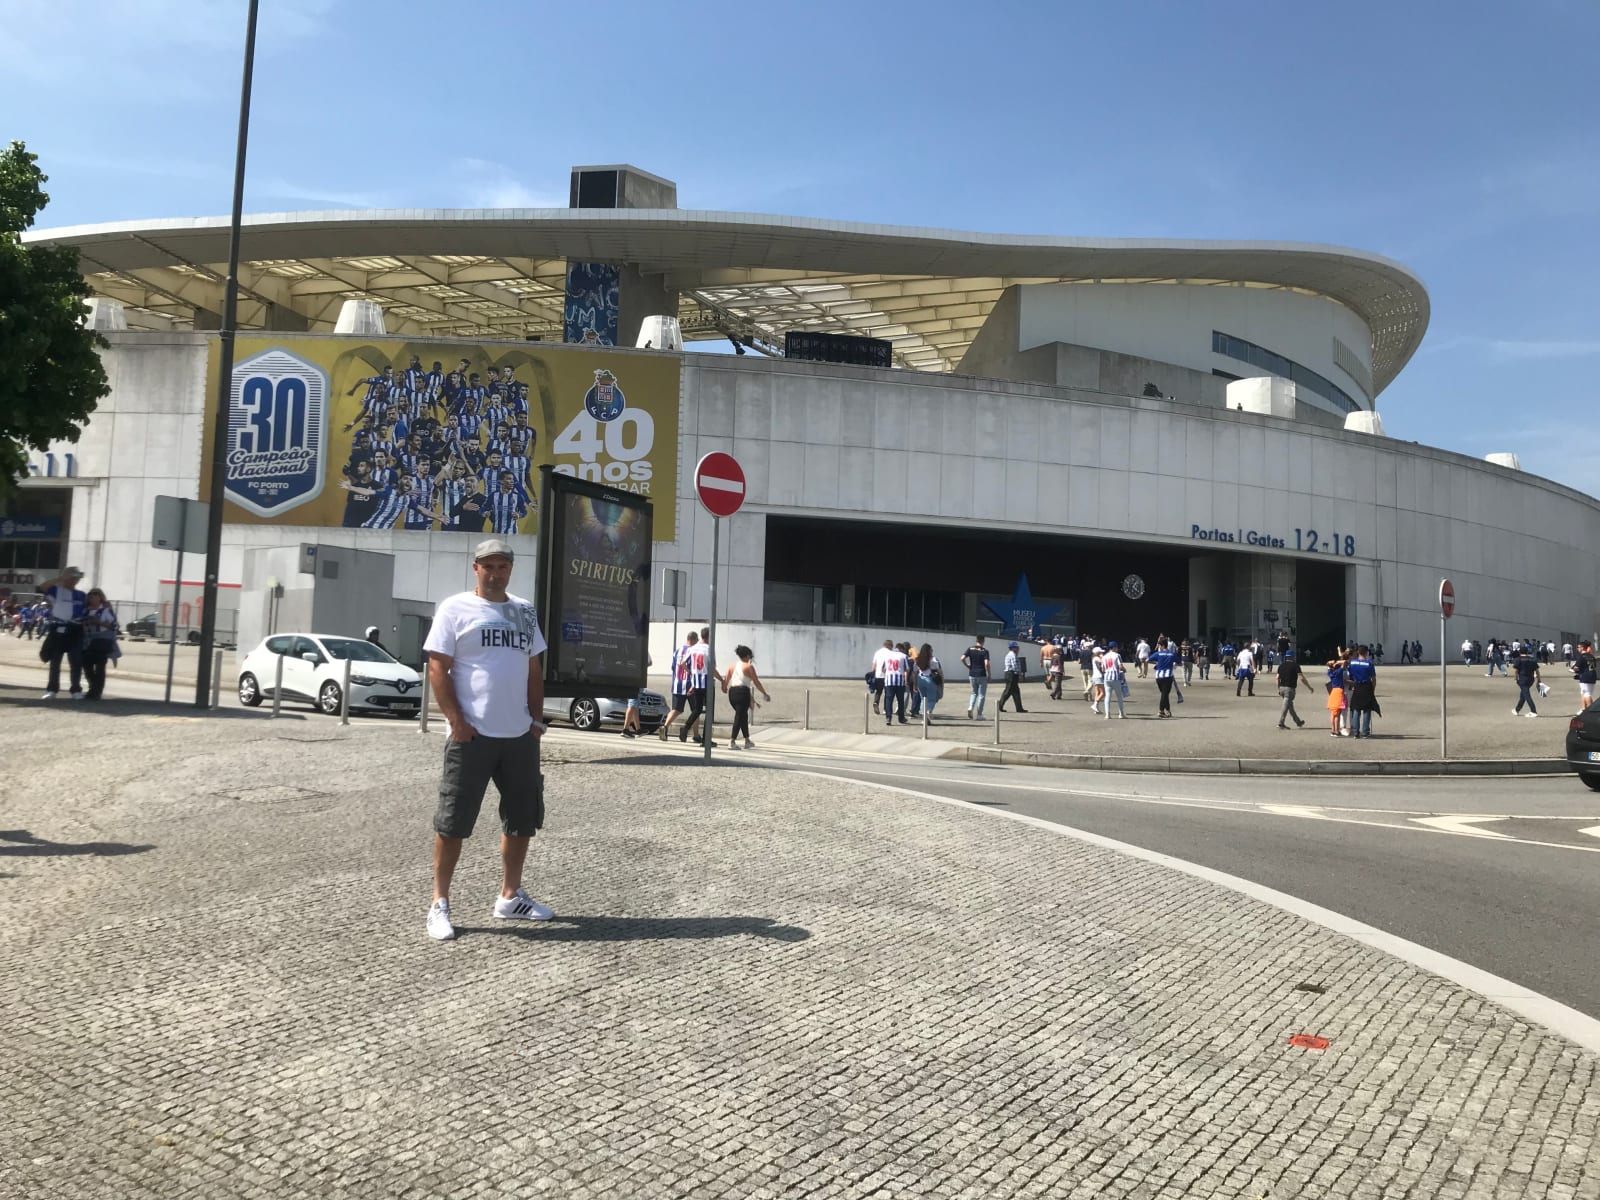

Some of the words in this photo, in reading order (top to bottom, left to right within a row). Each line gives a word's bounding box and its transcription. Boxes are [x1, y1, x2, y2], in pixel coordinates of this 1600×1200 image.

[239, 376, 306, 453] 30
[553, 407, 655, 463] 40
[228, 447, 313, 466] Campeão
[228, 460, 307, 479] Nacional
[552, 461, 653, 483] anos
[248, 481, 259, 489] FC
[1192, 524, 1234, 543] Portas
[1246, 531, 1285, 548] Gates
[569, 558, 635, 585] SPIRITUS
